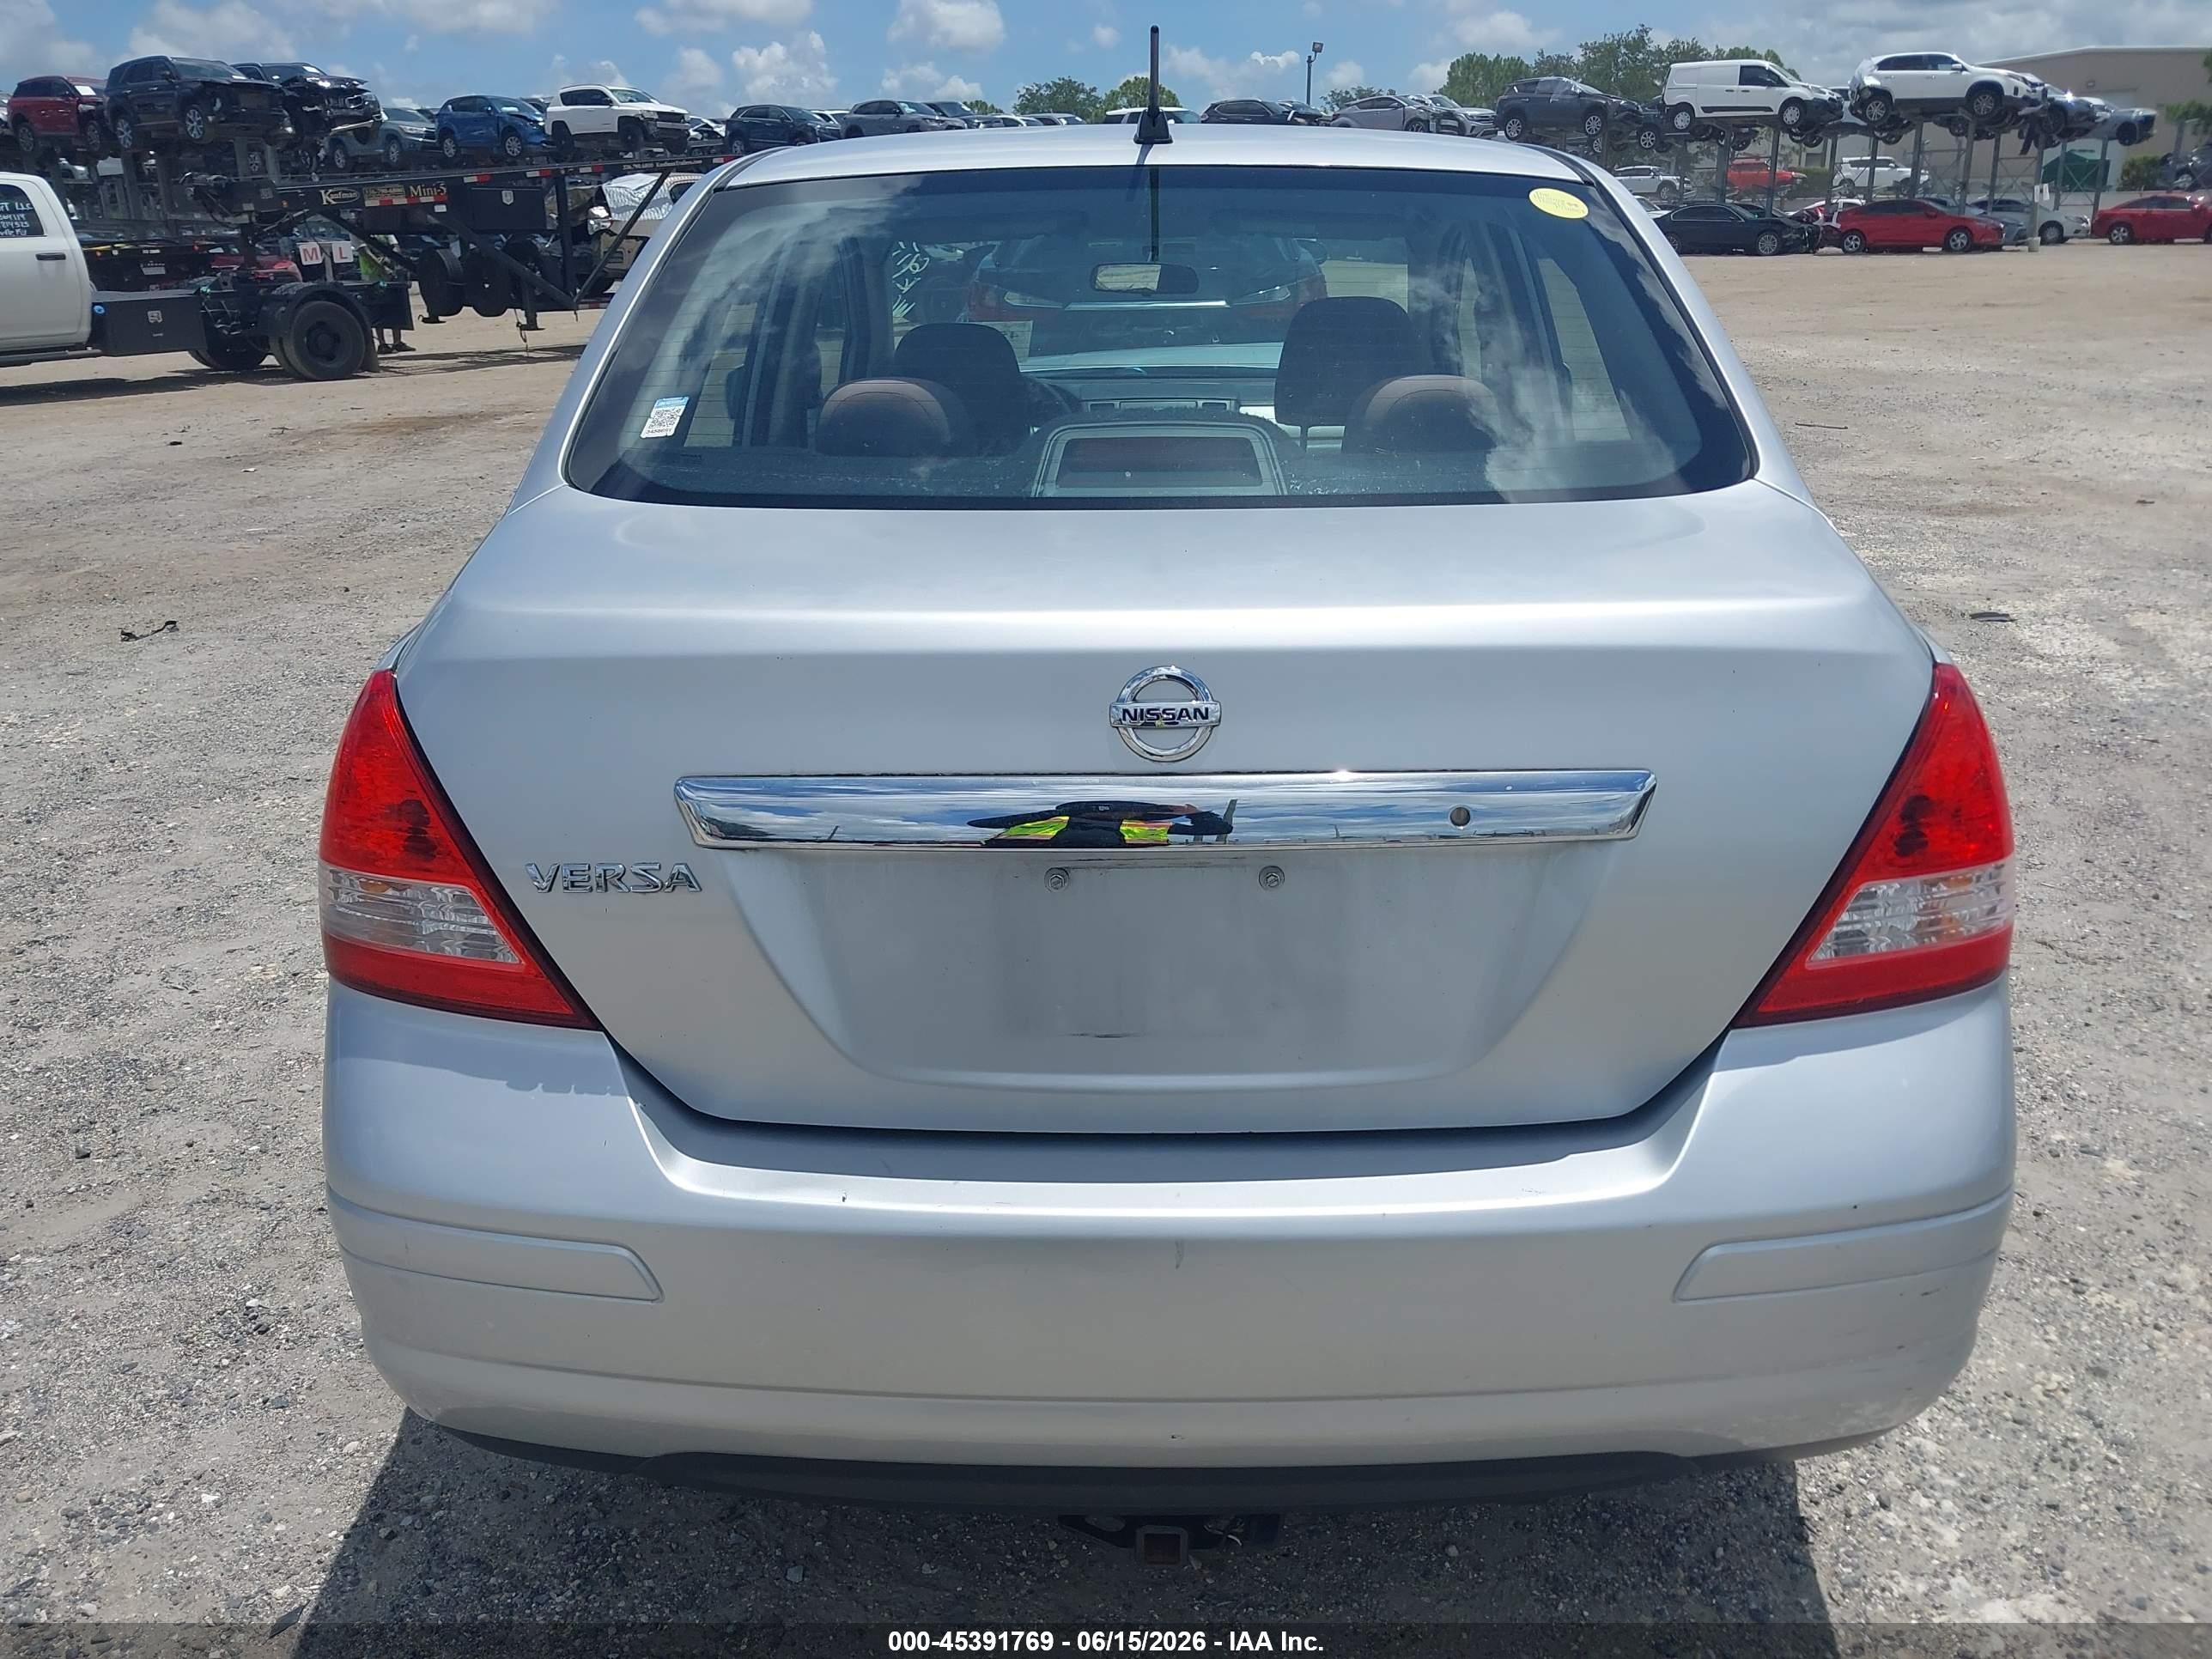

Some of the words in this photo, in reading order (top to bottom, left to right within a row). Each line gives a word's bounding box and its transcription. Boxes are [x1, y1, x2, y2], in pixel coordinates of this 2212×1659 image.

[319, 189, 357, 205] Kaufman
[409, 182, 447, 197] Mini-5
[302, 246, 319, 262] M
[338, 246, 348, 259] L
[1121, 707, 1209, 721] NISSAN
[525, 862, 702, 893] VERSA
